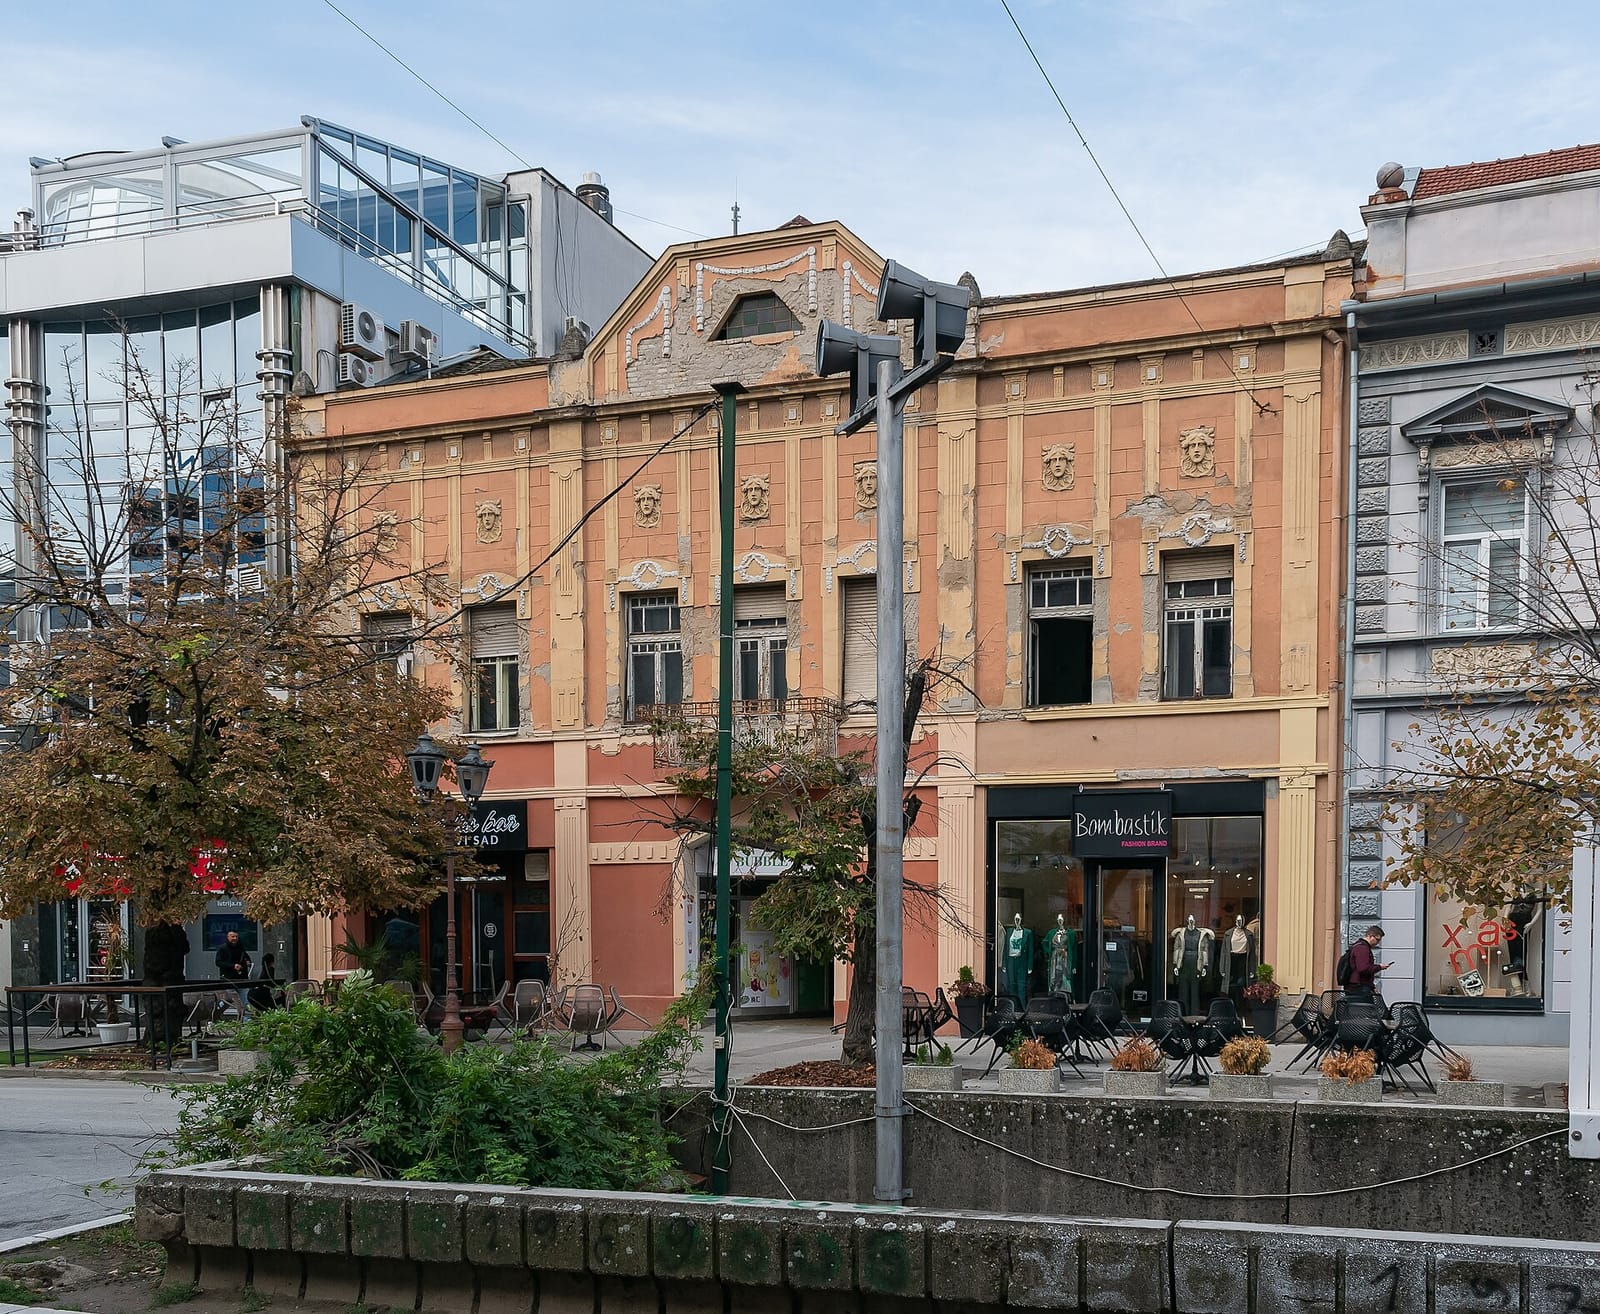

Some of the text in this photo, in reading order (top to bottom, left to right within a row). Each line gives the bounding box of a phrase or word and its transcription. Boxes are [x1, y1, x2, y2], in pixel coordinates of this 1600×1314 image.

[481, 809, 520, 833] bar
[1074, 809, 1168, 837] Bombastik
[473, 835, 499, 845] SAD
